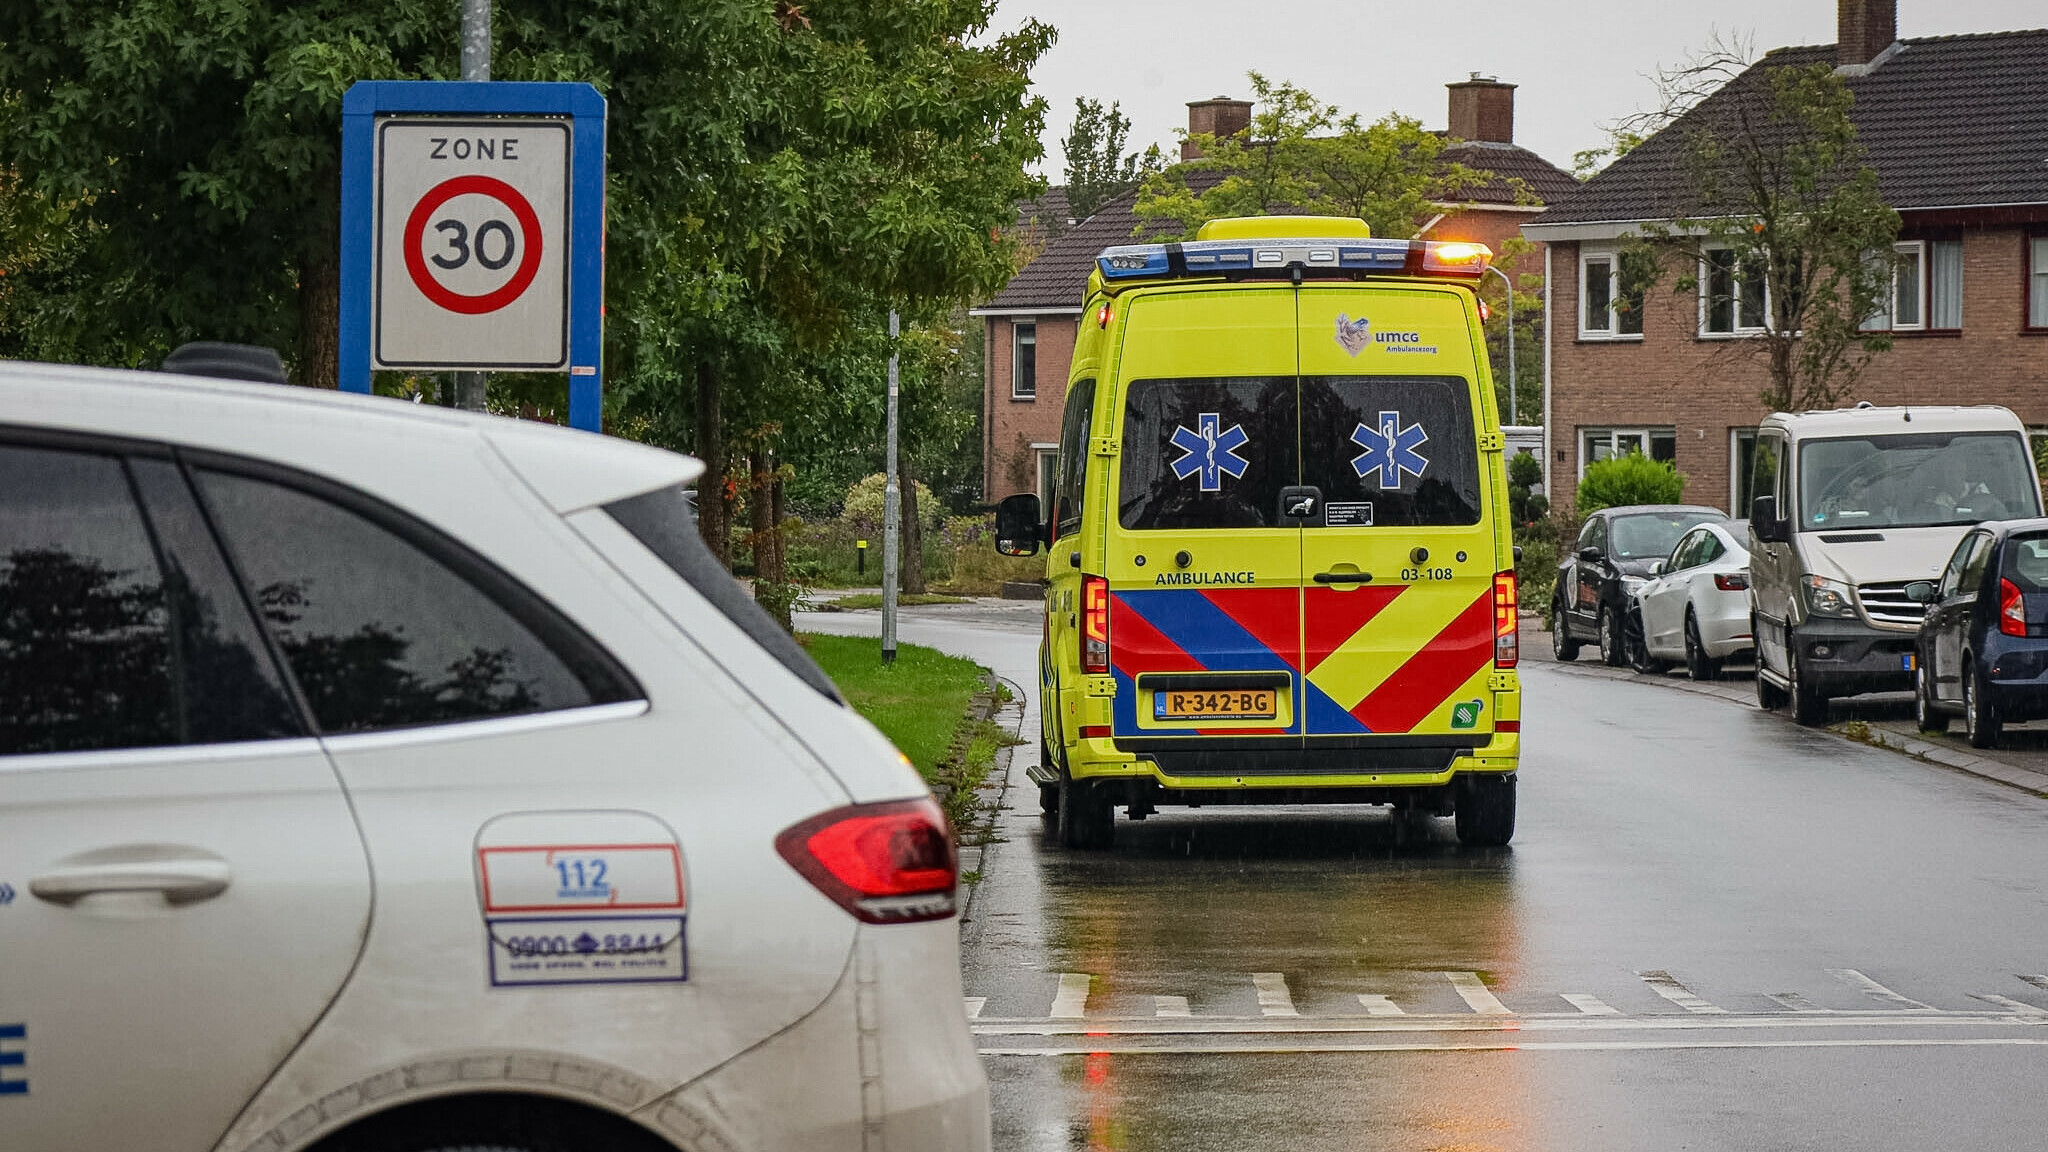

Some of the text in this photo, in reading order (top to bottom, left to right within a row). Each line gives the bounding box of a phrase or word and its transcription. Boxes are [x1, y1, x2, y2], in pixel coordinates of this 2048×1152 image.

[430, 138, 519, 160] ZONE
[430, 219, 515, 271] 30
[1386, 345, 1437, 353] Ambulancezorg
[1155, 571, 1255, 585] AMBULANCE
[1401, 568, 1453, 581] 03-108
[1173, 693, 1268, 712] R-342-BG
[556, 859, 610, 888] 112
